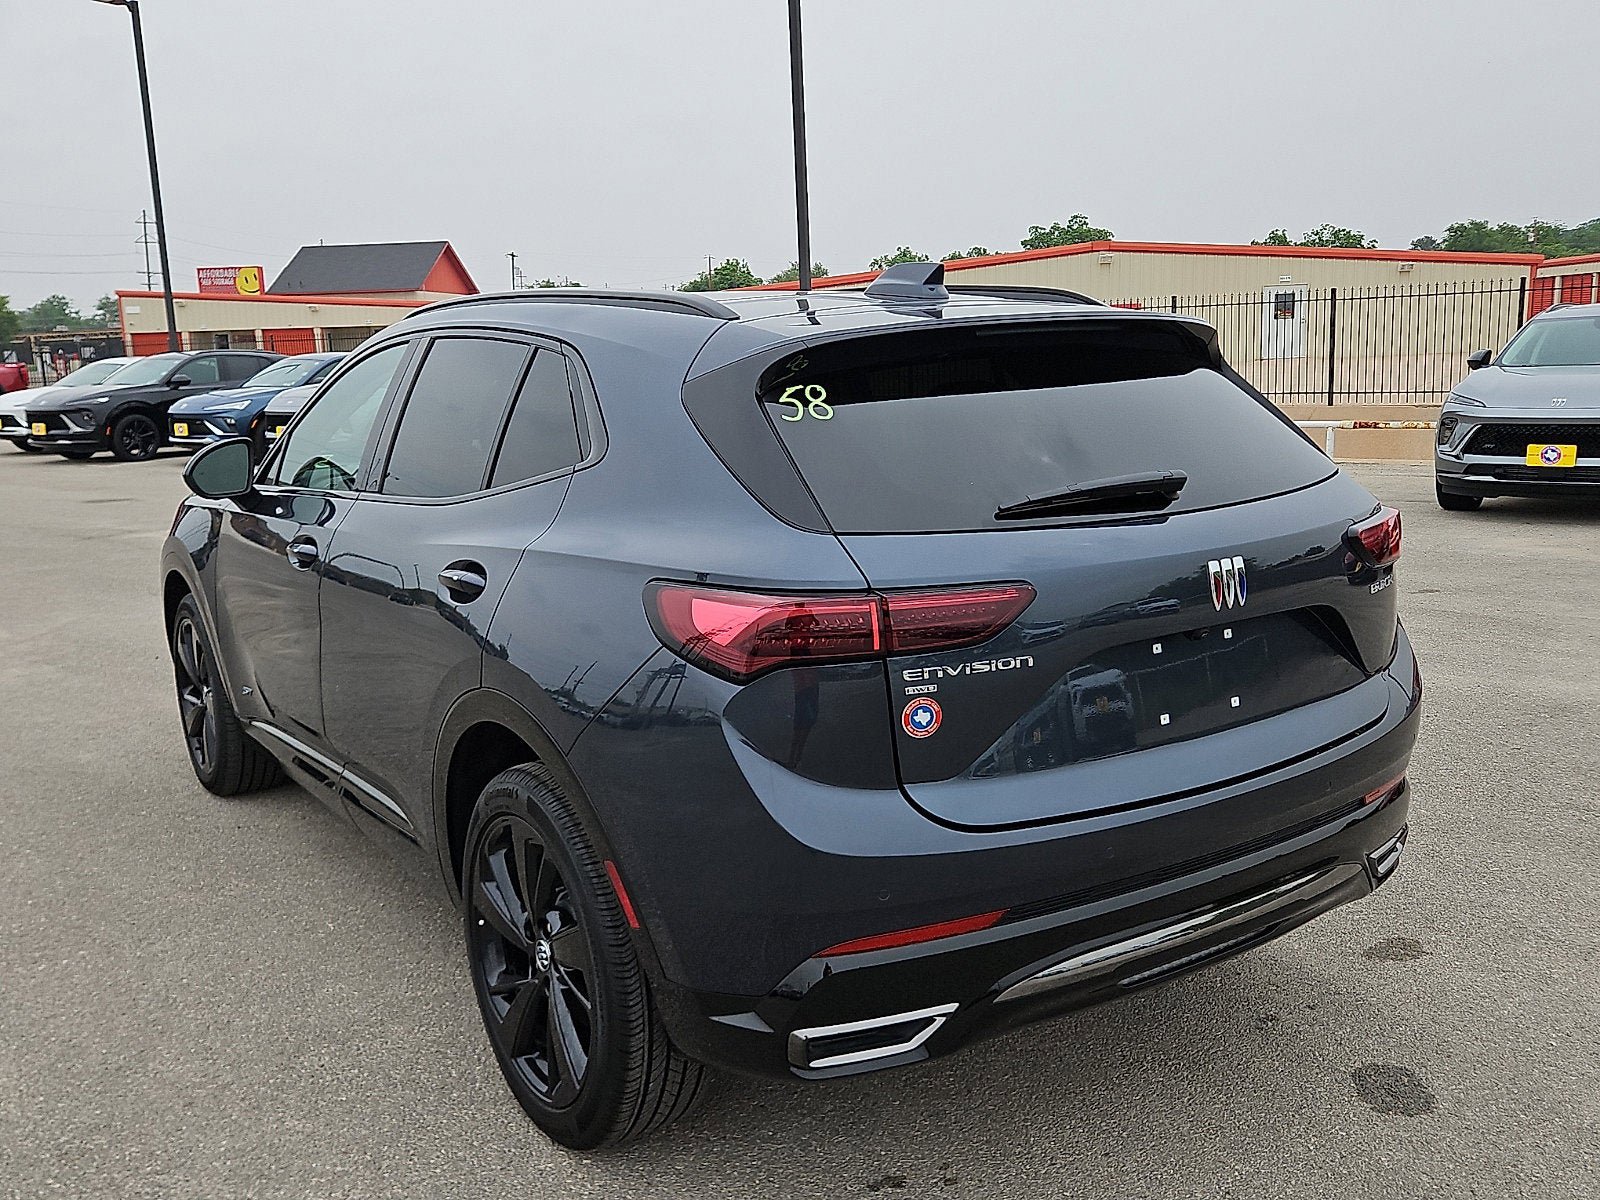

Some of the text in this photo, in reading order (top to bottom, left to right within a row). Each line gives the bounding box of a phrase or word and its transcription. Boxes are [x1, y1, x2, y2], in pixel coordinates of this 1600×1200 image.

[779, 384, 834, 421] 58
[1370, 574, 1394, 595] BUICK
[902, 655, 1034, 681] ENVISION
[905, 685, 937, 694] AWD
